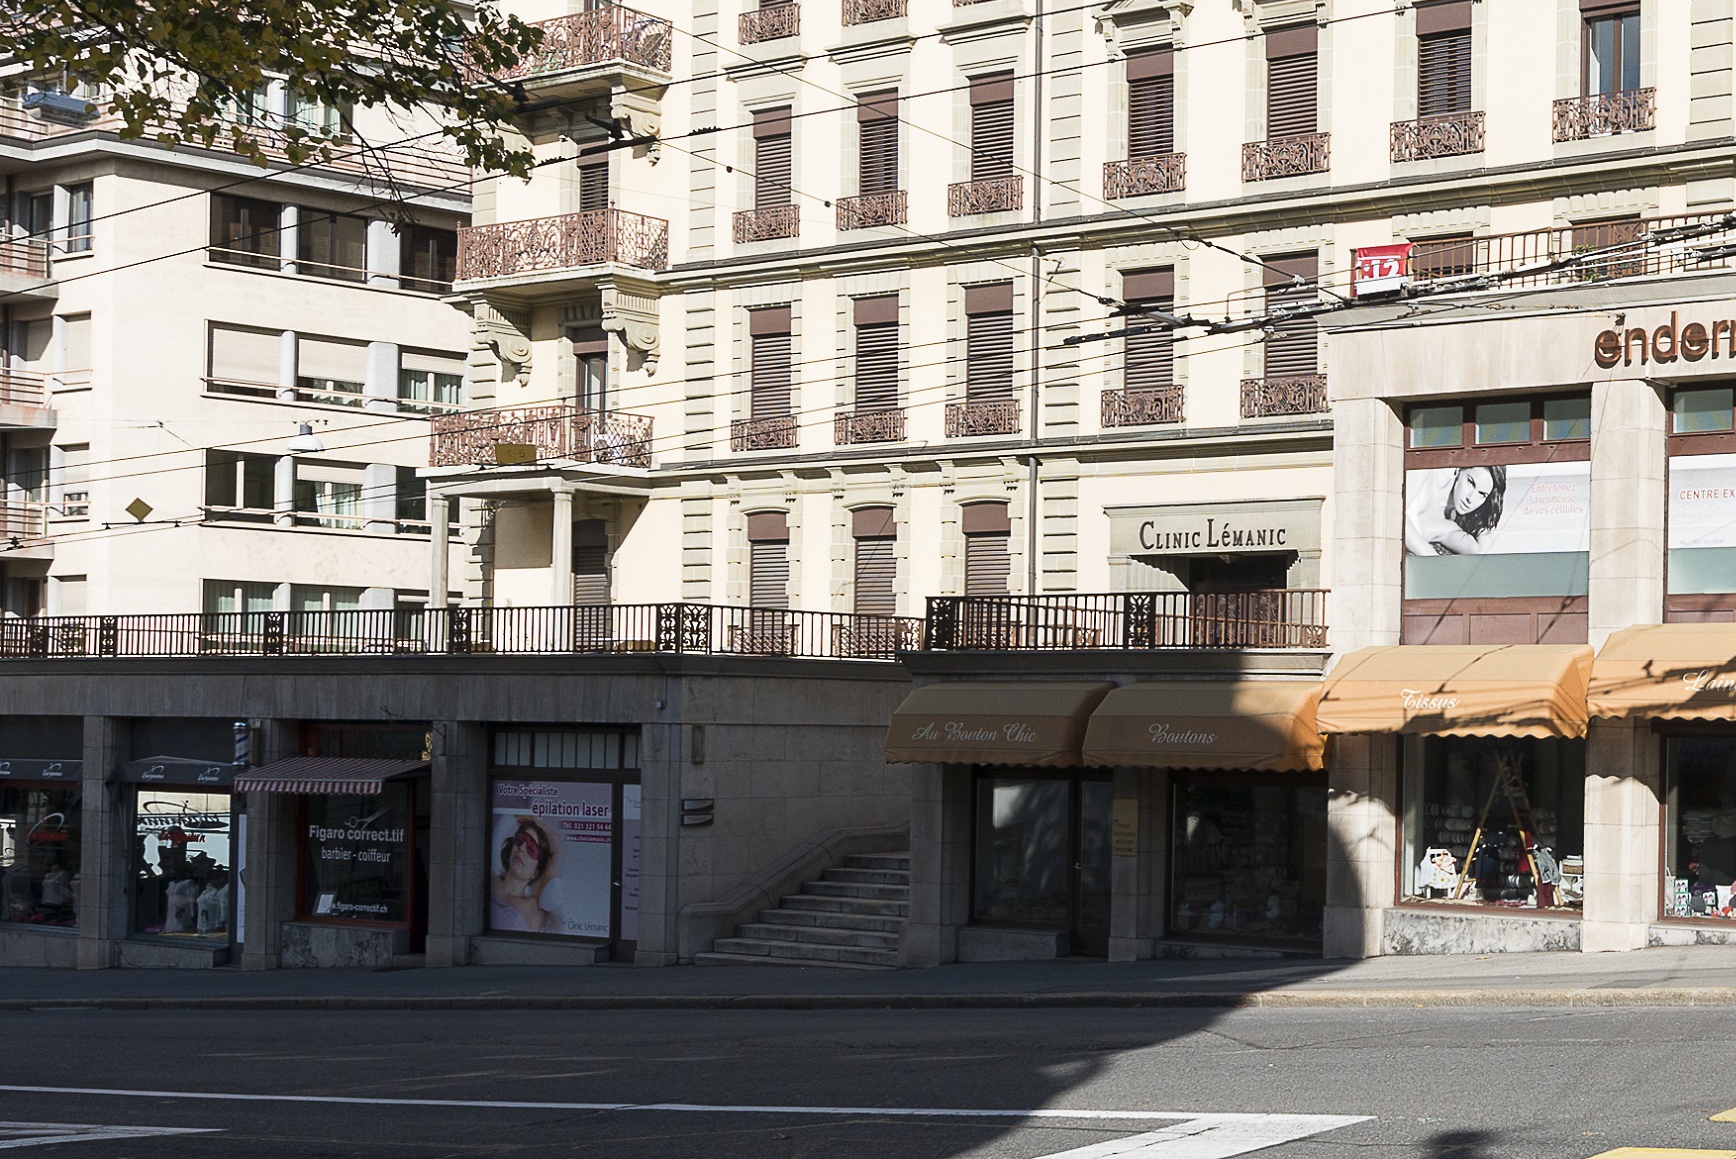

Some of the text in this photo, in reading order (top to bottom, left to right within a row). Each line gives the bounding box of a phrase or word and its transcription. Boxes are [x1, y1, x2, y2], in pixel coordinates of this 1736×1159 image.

[1679, 489, 1719, 500] CENTRE
[1550, 505, 1583, 514] cellules
[1139, 521, 1200, 550] CLINIC
[1400, 688, 1460, 710] Tissus
[912, 722, 1038, 743] Au Bouton Chic
[1148, 723, 1218, 745] Boutons
[498, 783, 559, 799] Votre Spécialiste
[532, 800, 610, 818] épilation laser
[309, 824, 405, 842] Figaro correct.tif
[321, 846, 351, 860] barbier
[358, 848, 391, 863] coiffeur
